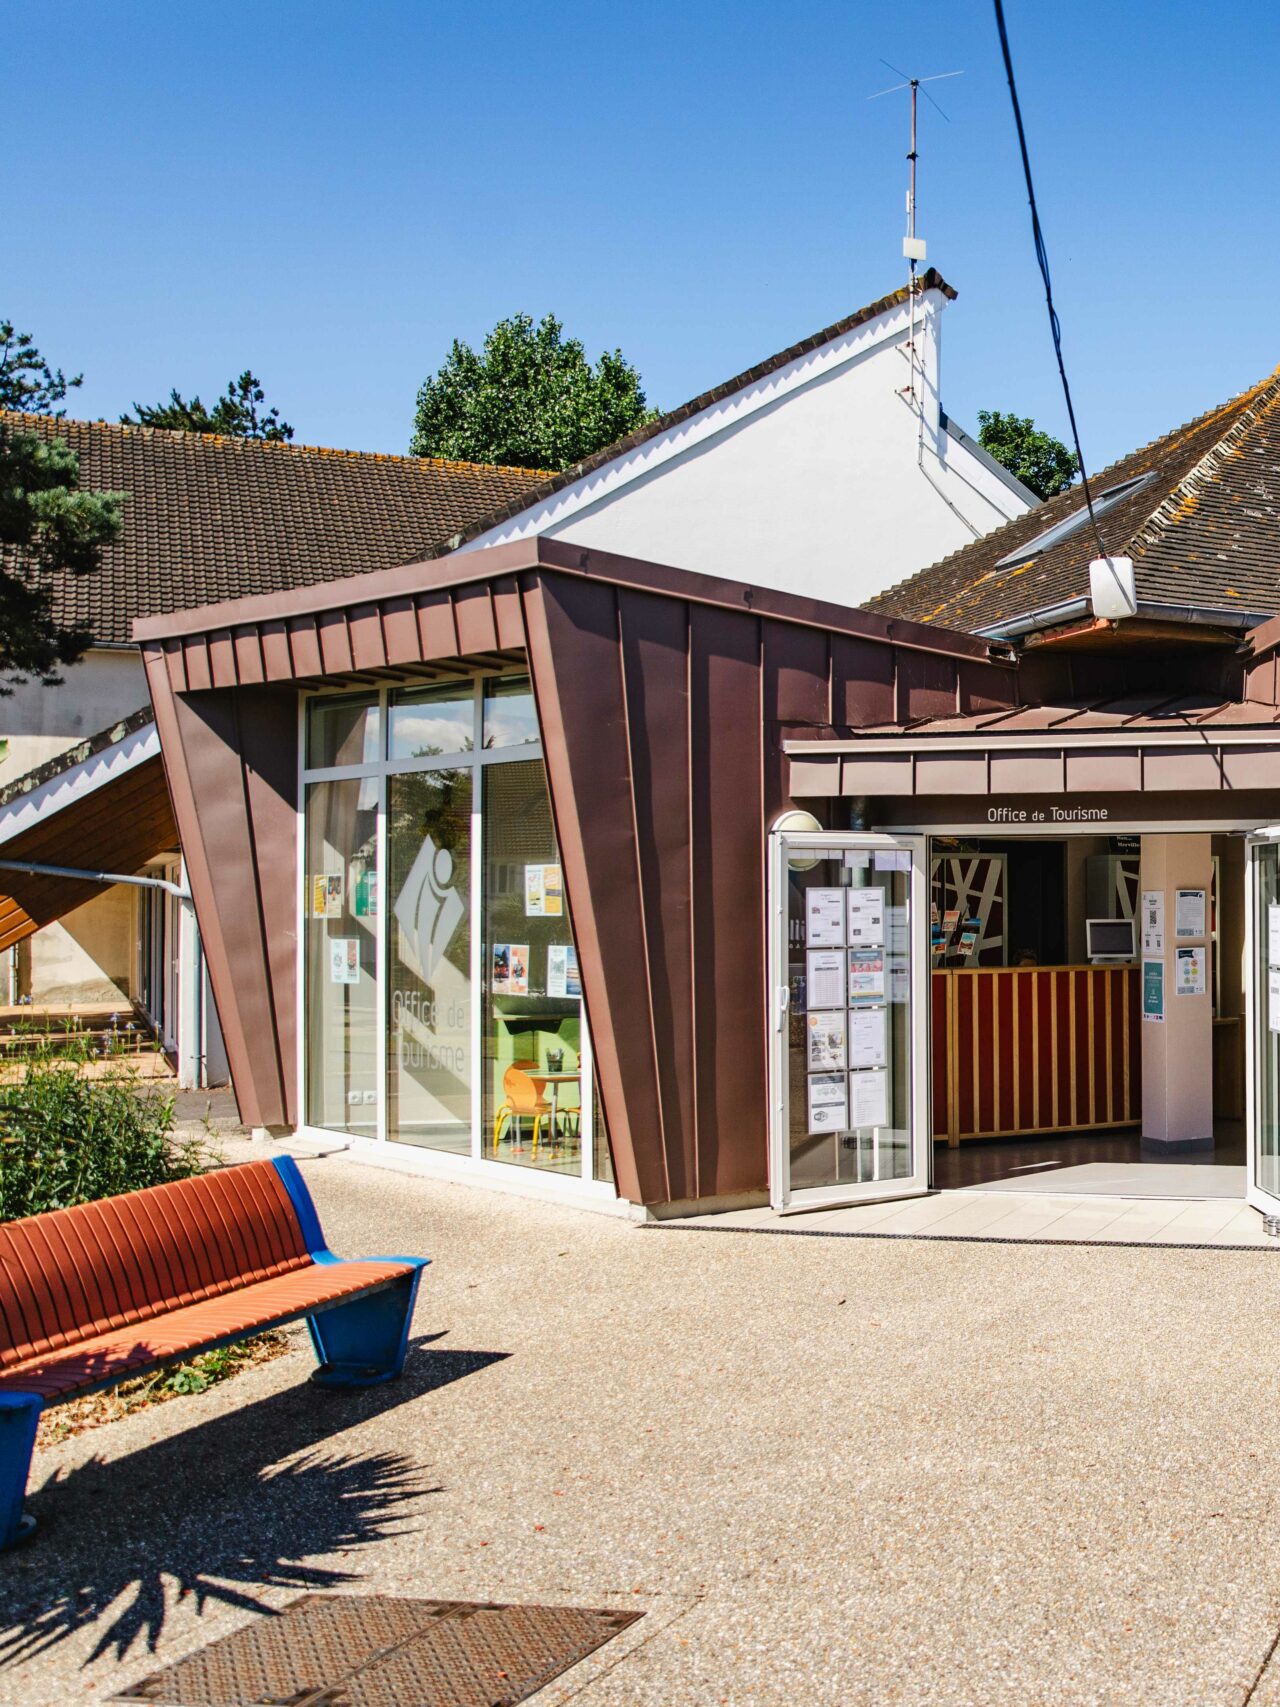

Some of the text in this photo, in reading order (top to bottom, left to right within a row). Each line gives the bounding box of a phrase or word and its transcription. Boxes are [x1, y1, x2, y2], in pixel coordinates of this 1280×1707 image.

[987, 806, 1108, 822] Office de Tourisme
[392, 990, 466, 1033] Office de
[392, 1031, 466, 1073] Tourisme
